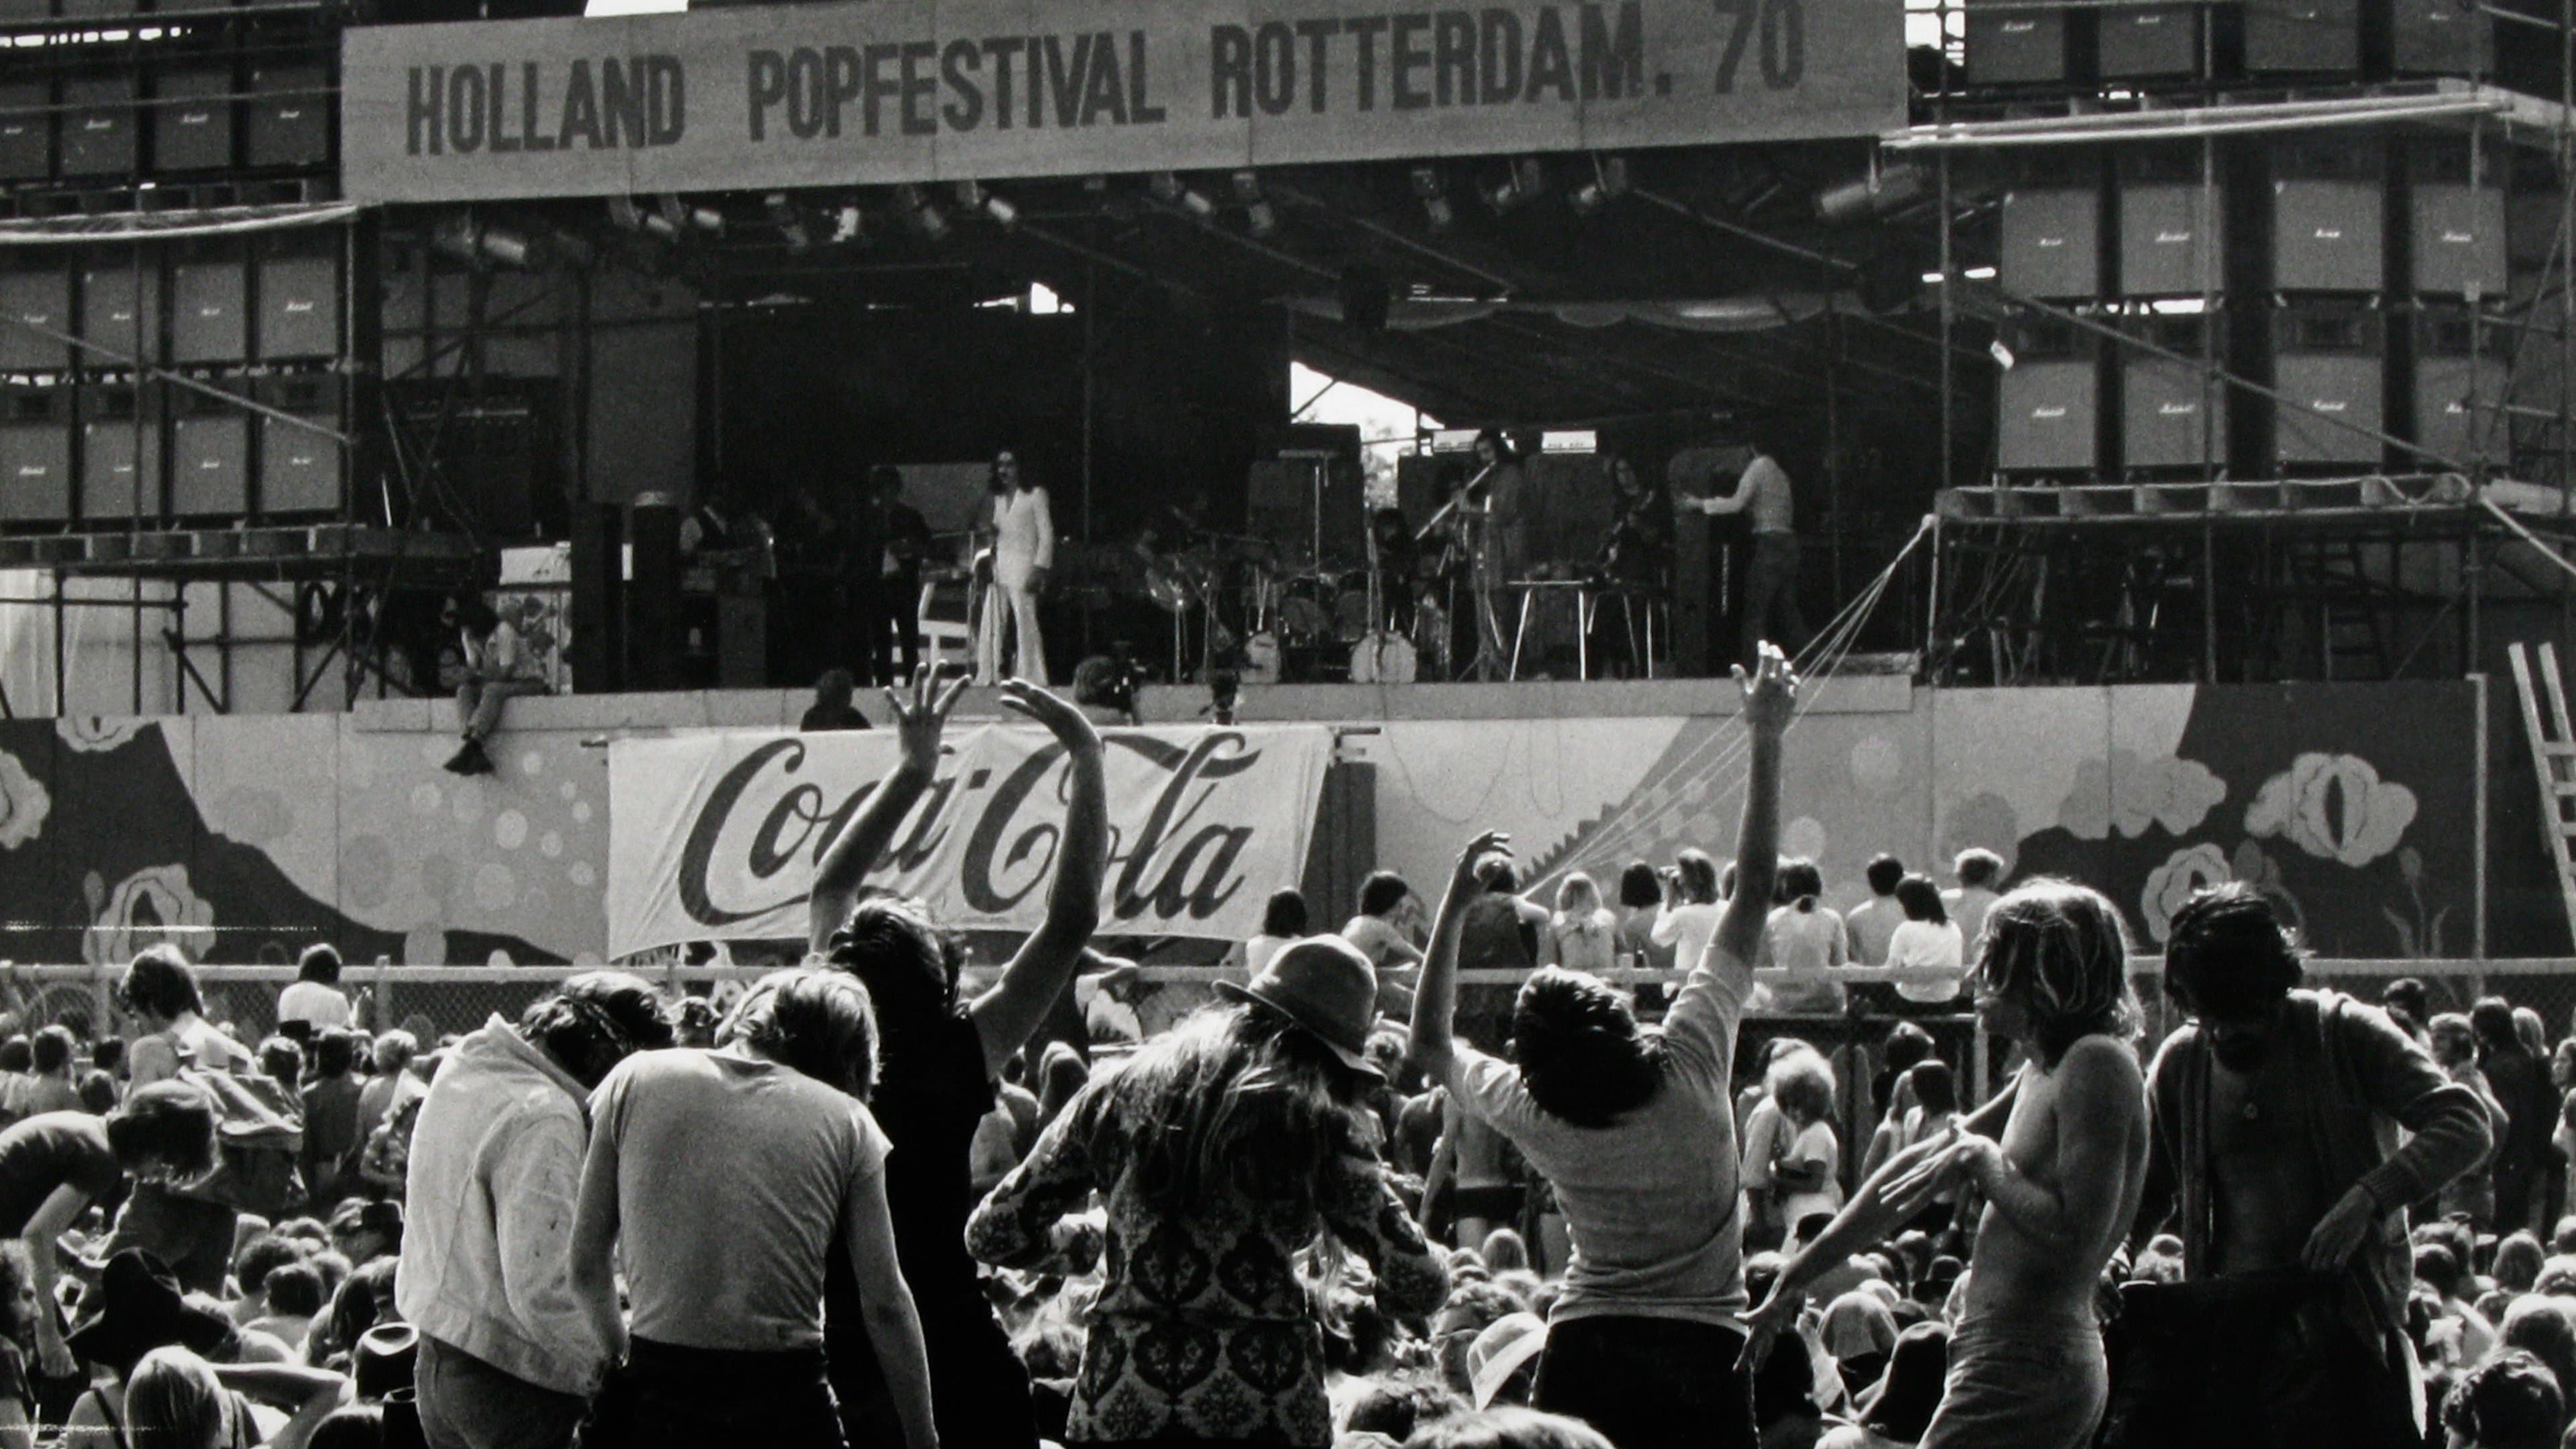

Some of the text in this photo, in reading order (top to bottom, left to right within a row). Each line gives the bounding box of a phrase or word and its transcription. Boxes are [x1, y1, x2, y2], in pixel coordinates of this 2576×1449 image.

[407, 0, 1803, 156] HOLLAND POPFESTIVAL ROTTERDAM. 70
[678, 732, 1262, 926] Coa-Cla
